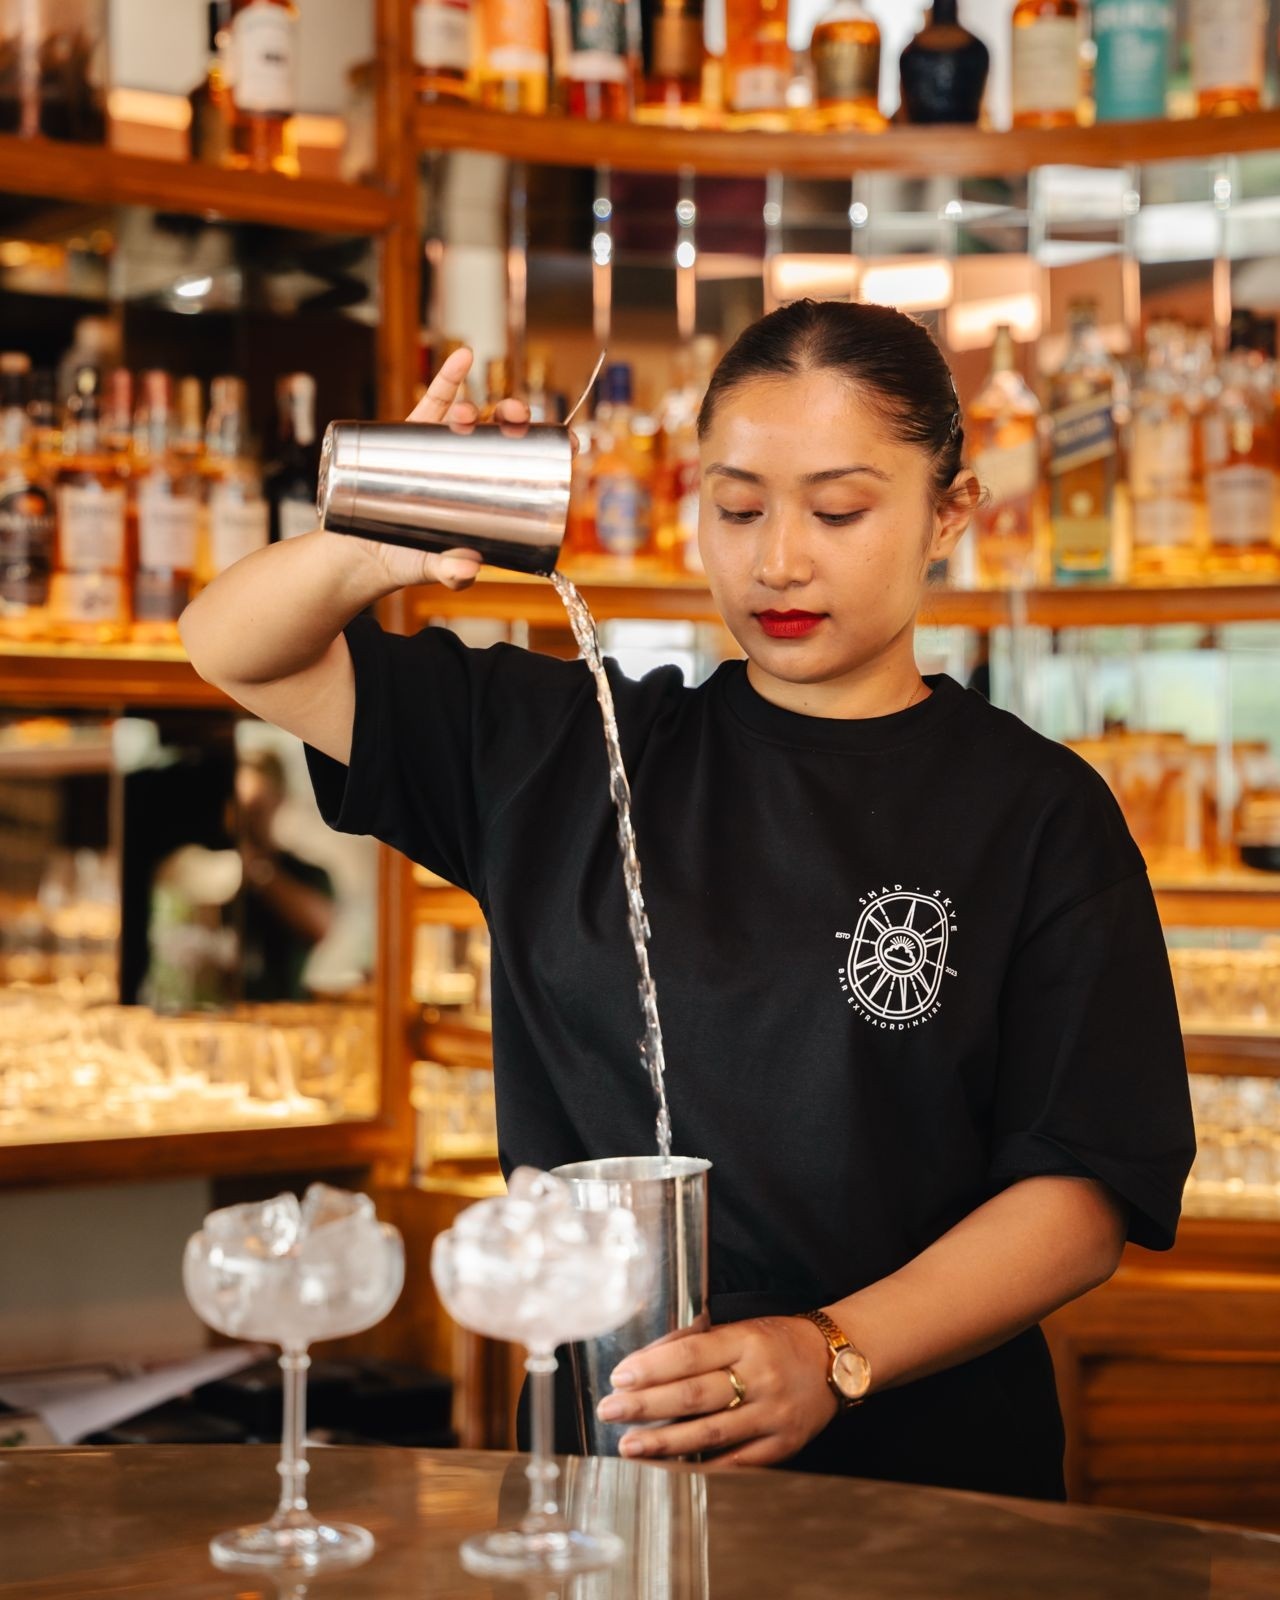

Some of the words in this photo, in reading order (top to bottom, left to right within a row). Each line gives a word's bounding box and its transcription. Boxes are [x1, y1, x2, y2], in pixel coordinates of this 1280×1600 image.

[858, 884, 903, 905] SHAD
[932, 889, 958, 932] SKYE
[834, 931, 851, 940] ESTD
[838, 967, 848, 992] BAR
[847, 996, 942, 1031] EXTRAORDINAIRE
